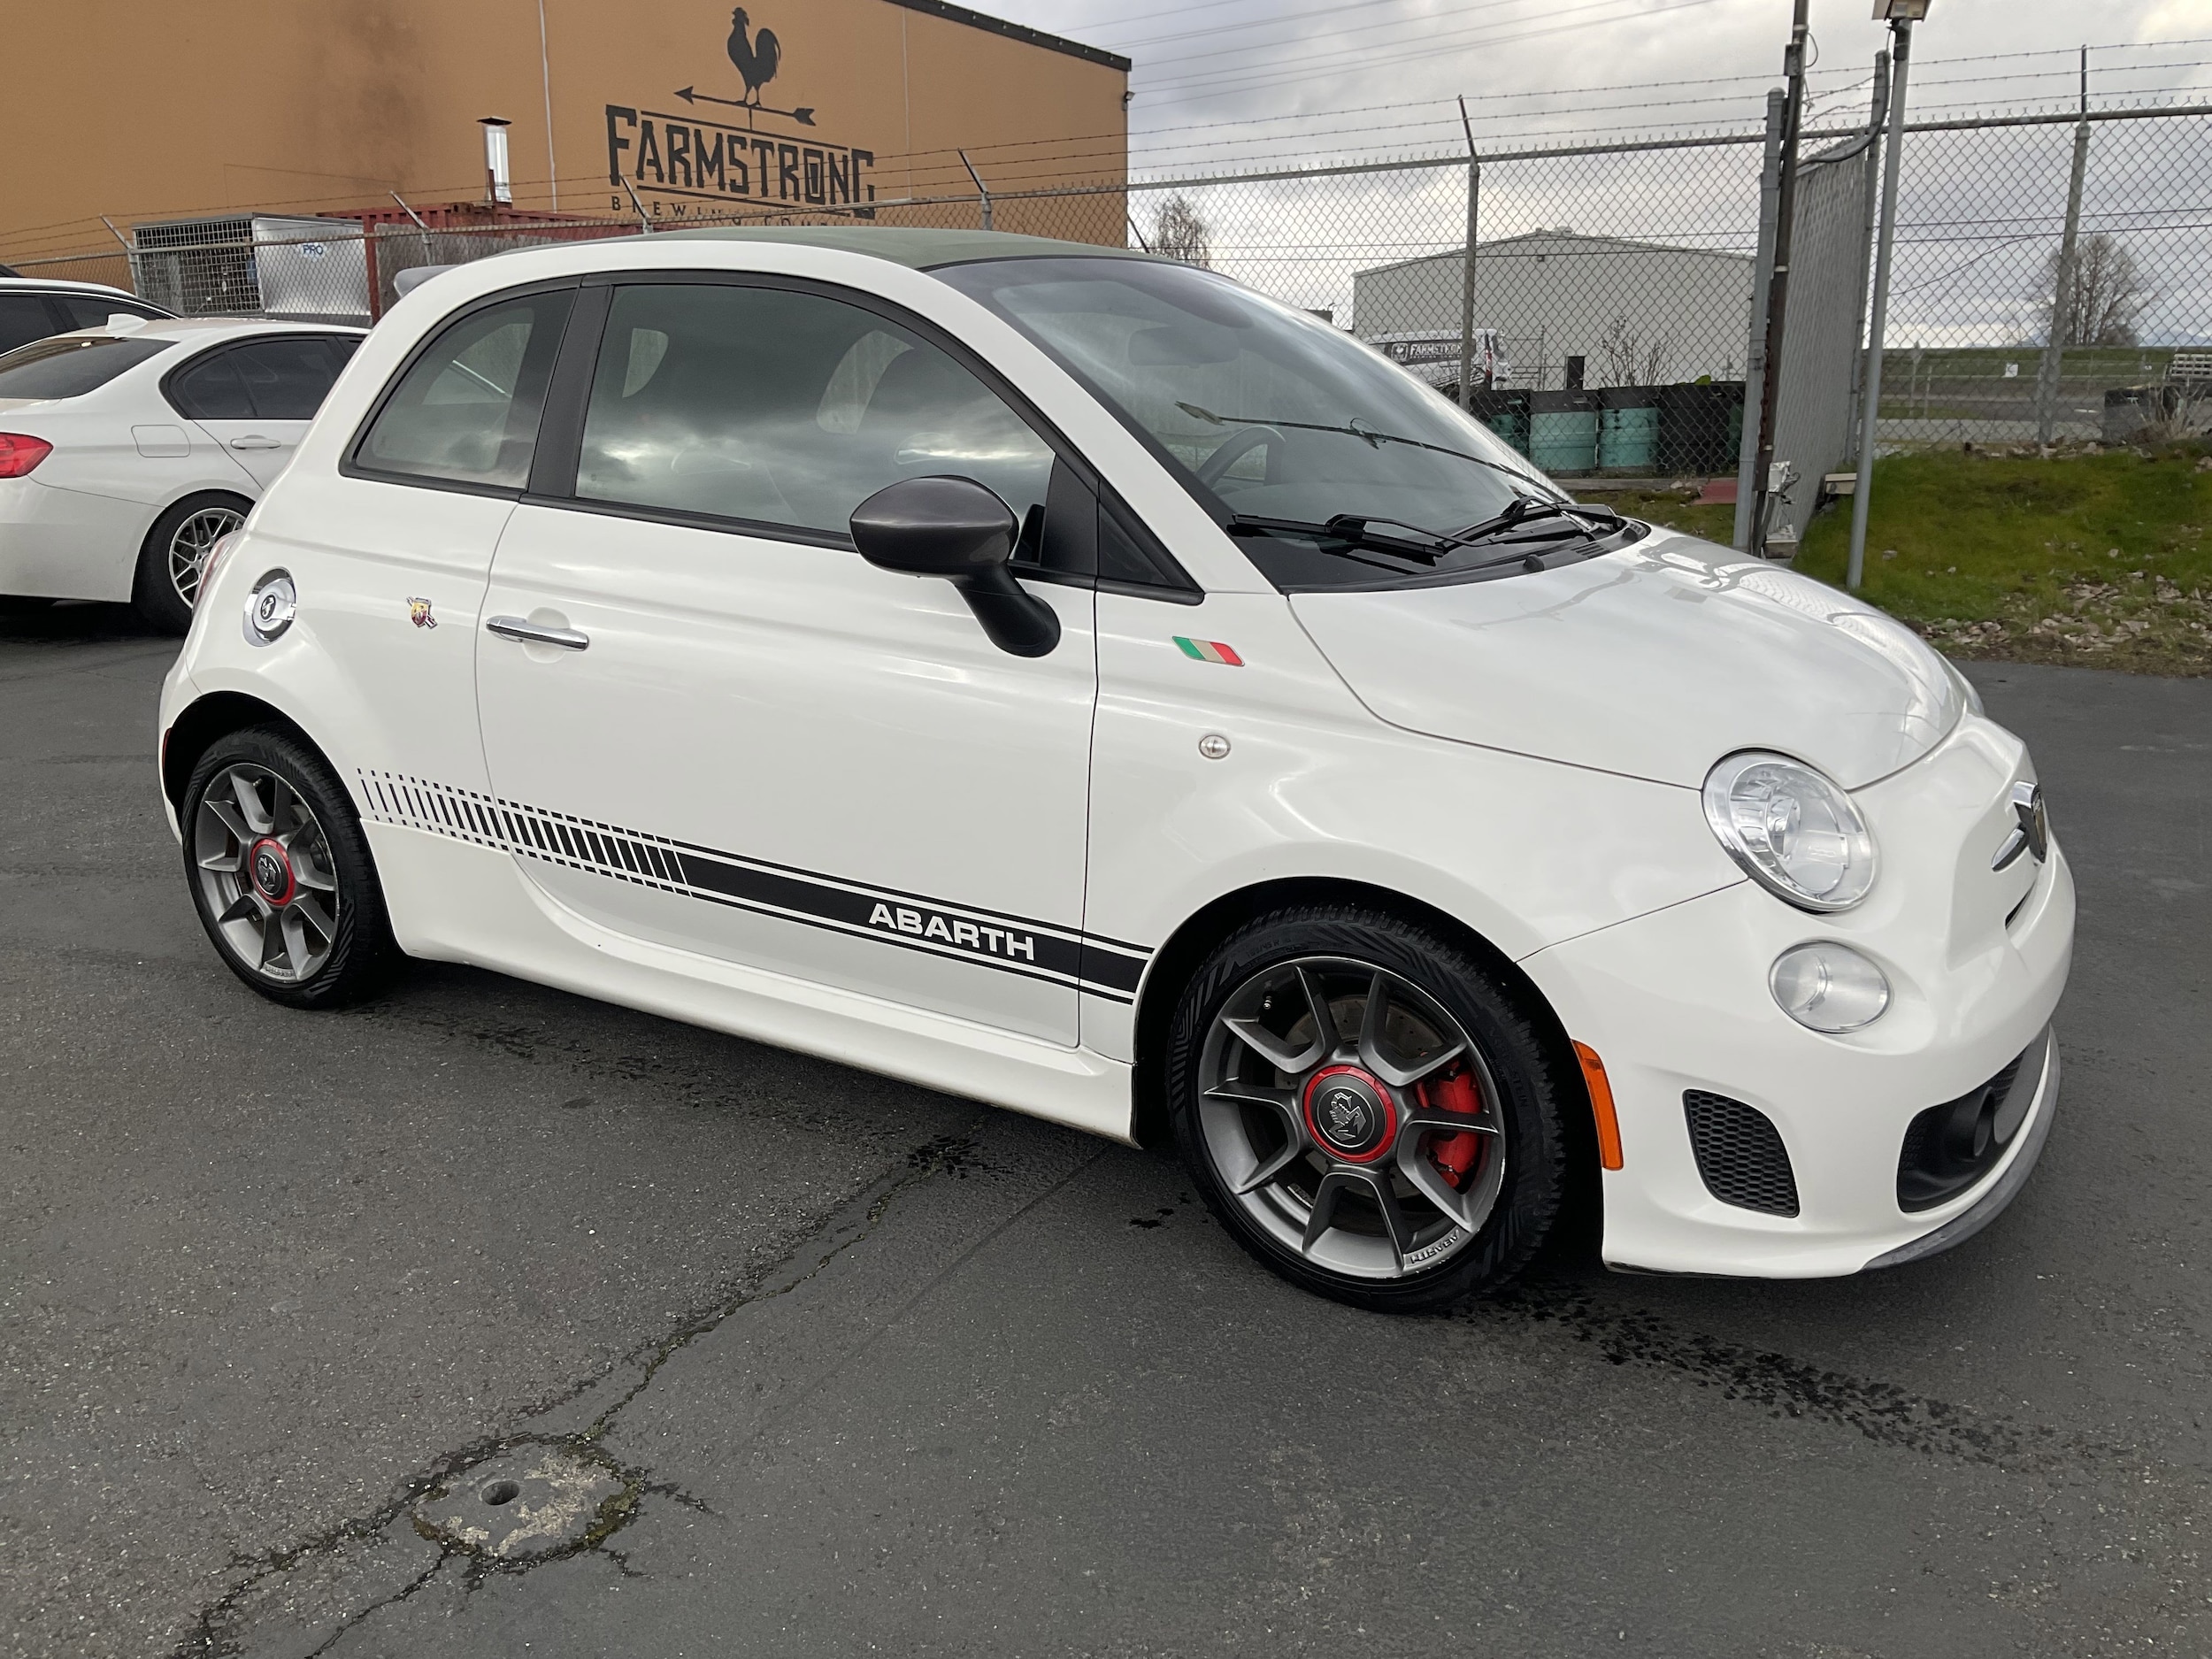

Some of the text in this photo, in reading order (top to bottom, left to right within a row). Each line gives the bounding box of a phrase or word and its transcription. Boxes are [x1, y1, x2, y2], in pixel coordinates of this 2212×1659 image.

[606, 104, 875, 219] FARMSTRONG
[303, 244, 324, 255] PRO
[1410, 343, 1462, 355] FARMSTRON
[869, 902, 1034, 961] ABARTH
[1410, 1229, 1459, 1263] ABARTH
